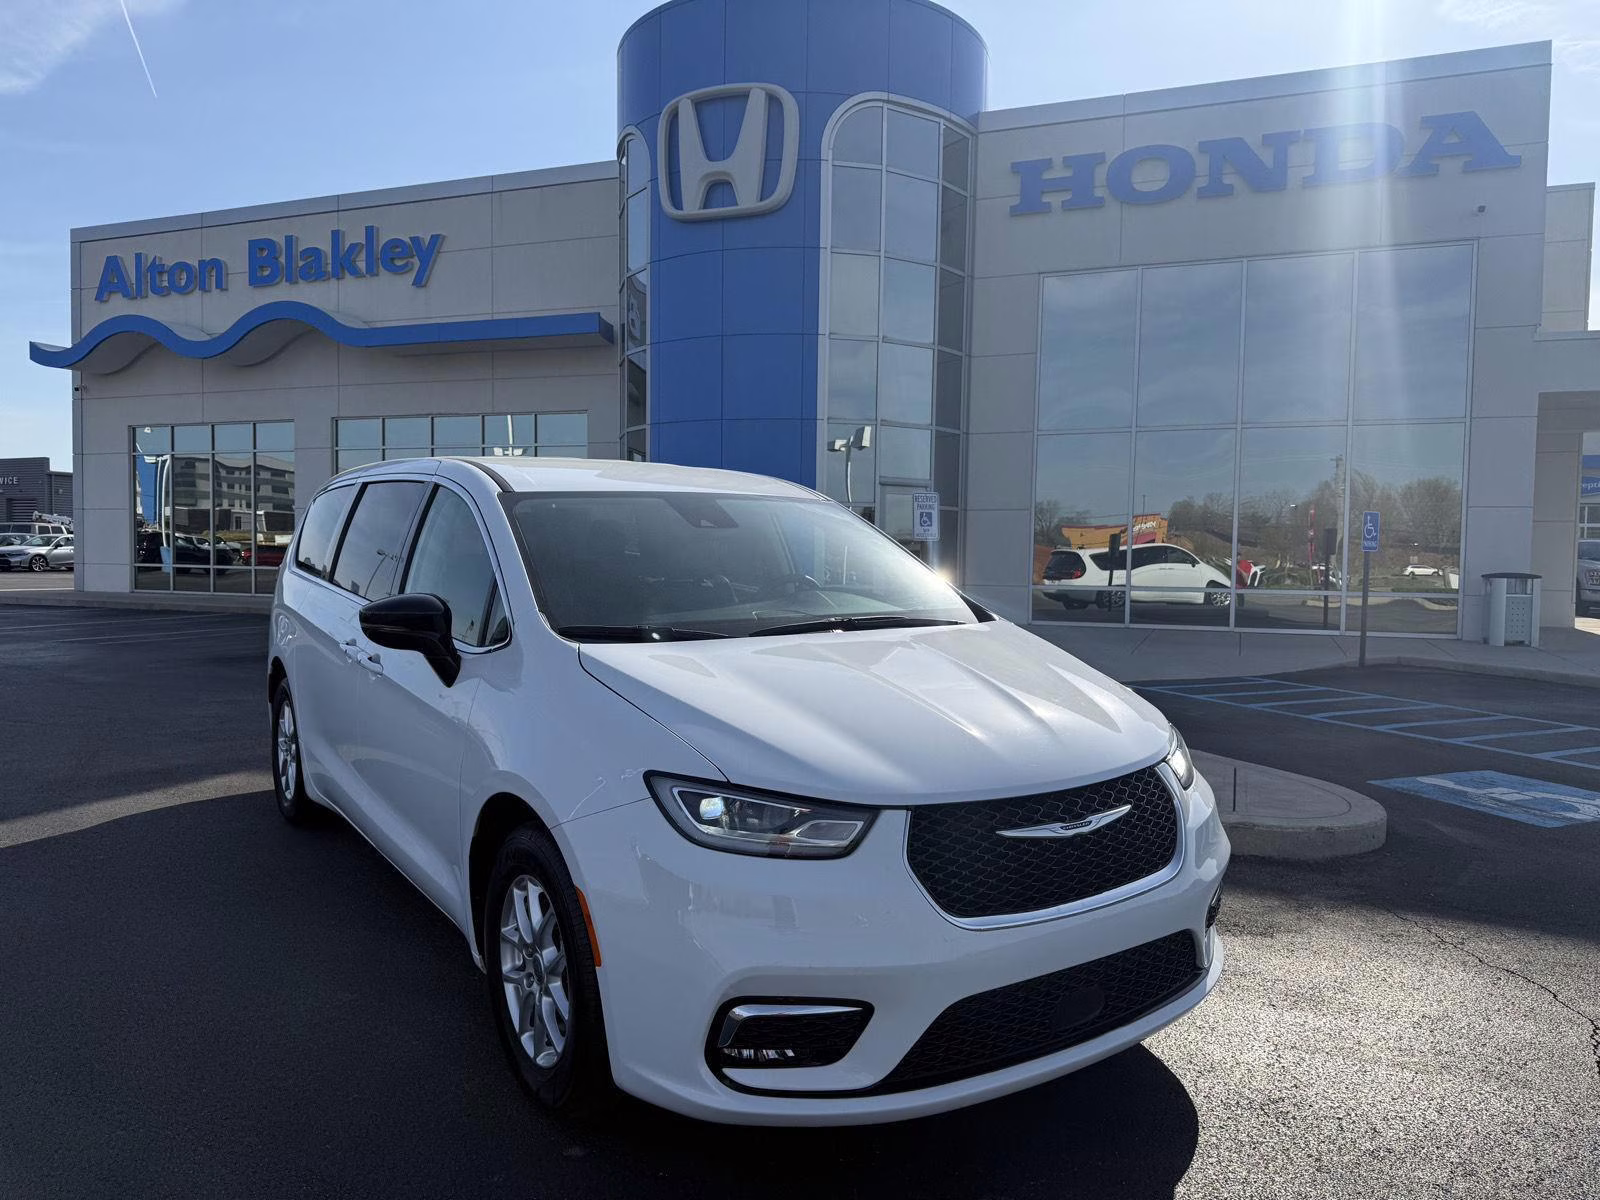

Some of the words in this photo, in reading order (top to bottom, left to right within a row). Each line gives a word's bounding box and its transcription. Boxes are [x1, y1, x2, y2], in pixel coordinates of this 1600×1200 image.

[1009, 111, 1521, 217] HONDA
[95, 252, 229, 302] Alton
[248, 225, 446, 288] Blakley
[915, 495, 937, 503] RESERVED
